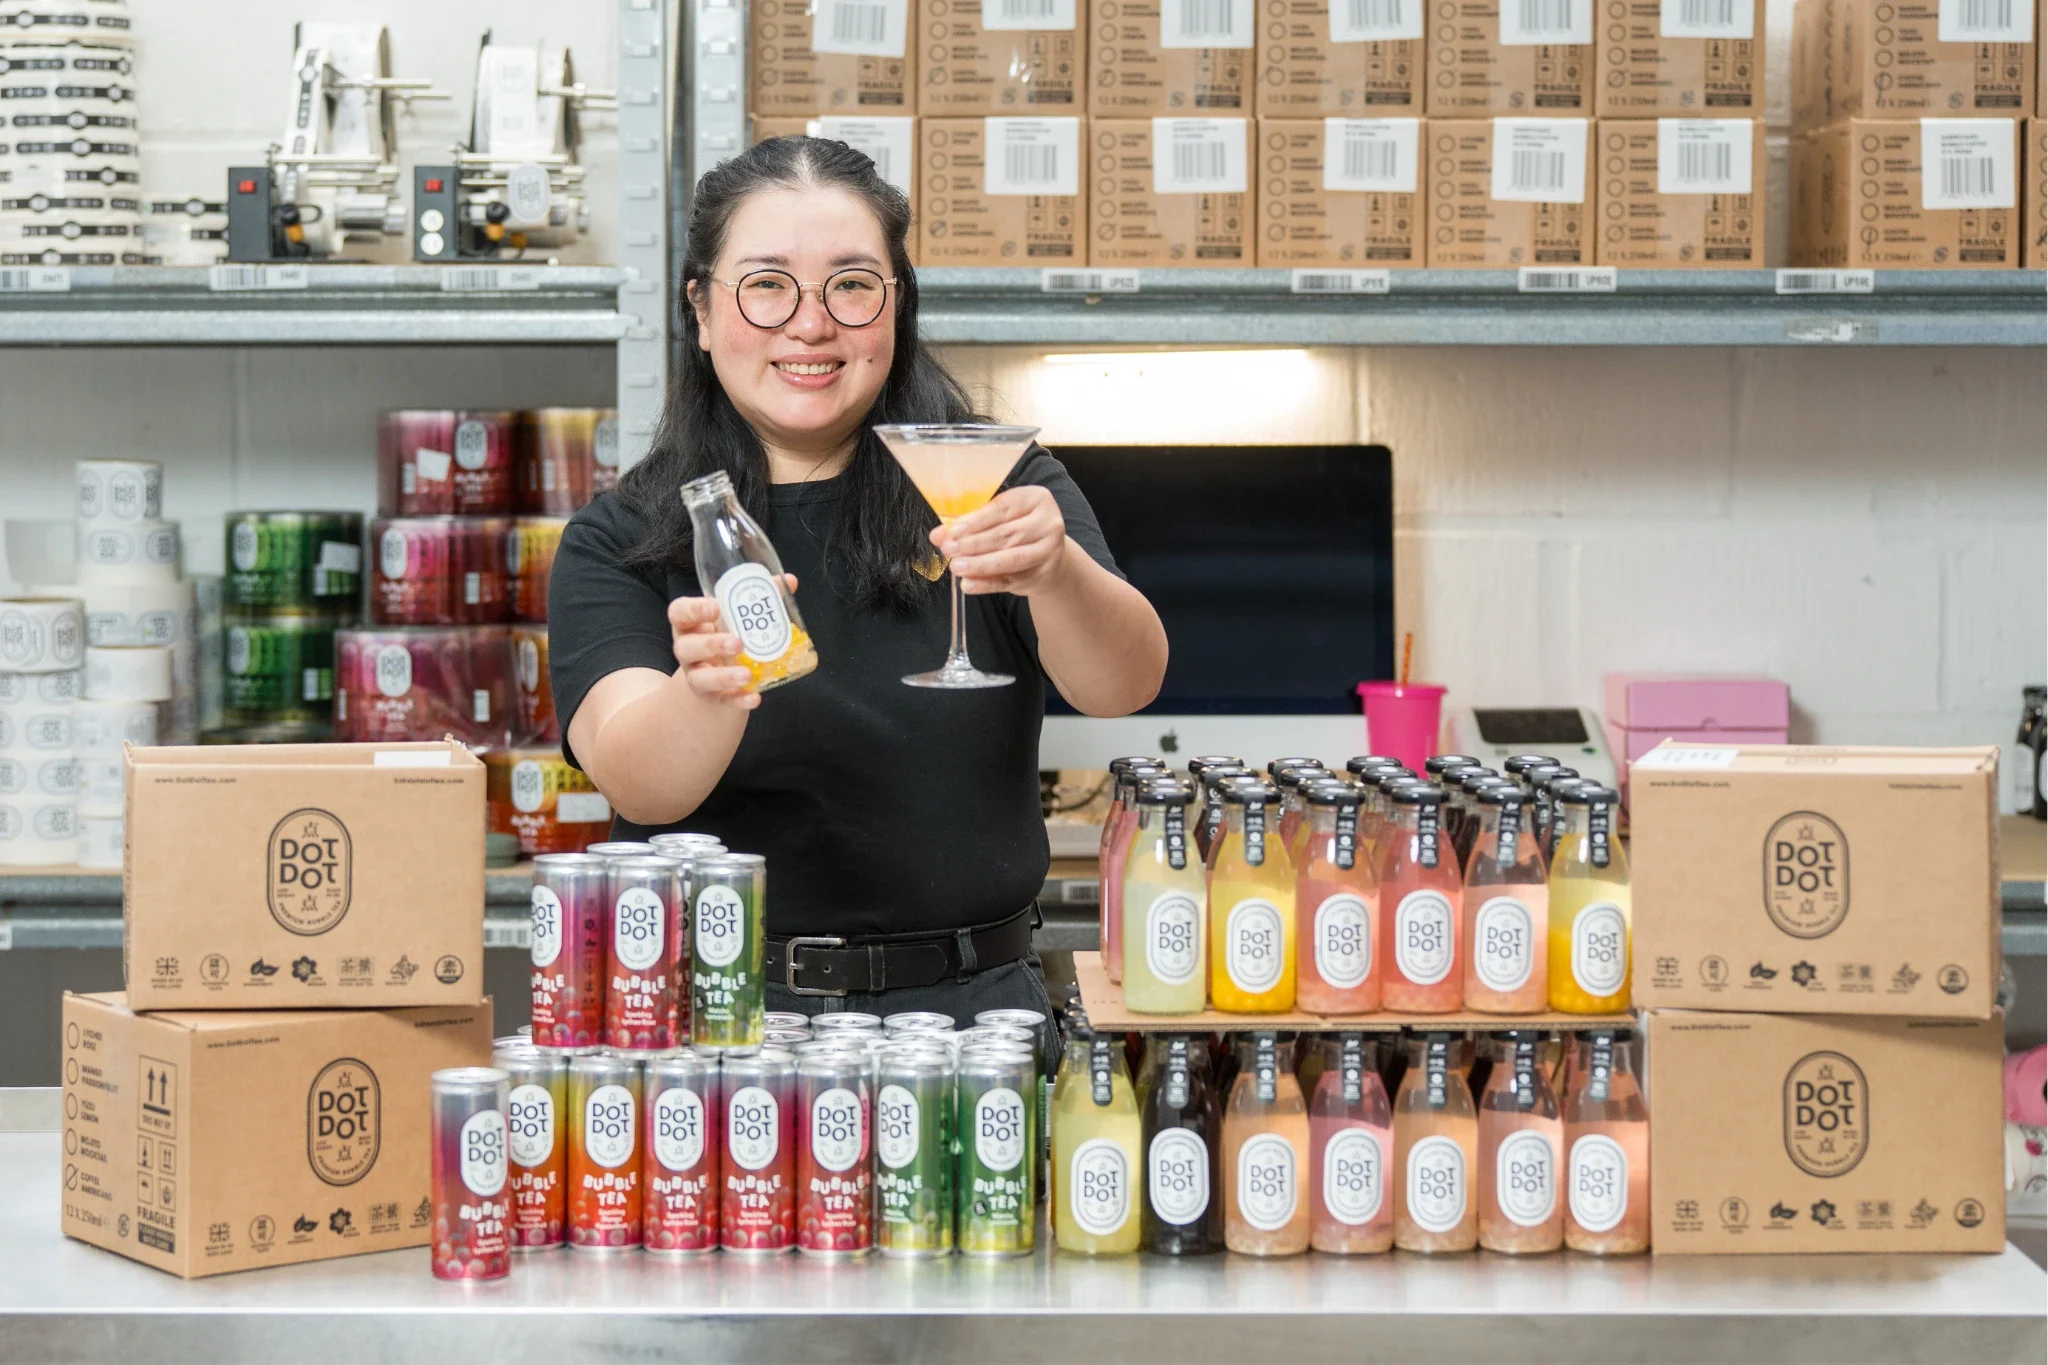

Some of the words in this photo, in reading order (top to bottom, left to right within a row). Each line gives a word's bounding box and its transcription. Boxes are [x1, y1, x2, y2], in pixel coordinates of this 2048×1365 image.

[1704, 83, 1752, 93] FRAGILE
[1974, 83, 2022, 92] FRAGILE
[1704, 237, 1752, 246] FRAGILE
[1959, 239, 2005, 247] FRAGILE
[738, 596, 772, 619] DOT
[742, 610, 776, 632] DOT
[281, 839, 339, 864] DOT
[1776, 841, 1835, 867] DOT
[281, 863, 339, 889] DOT
[1776, 865, 1835, 892] DOT
[621, 905, 658, 922] DOT
[701, 902, 738, 920] DOT
[621, 922, 658, 940] DOT
[701, 918, 738, 937] DOT
[1159, 920, 1192, 937] DOT
[1328, 924, 1362, 940] DOT
[1408, 920, 1444, 937] DOT
[1487, 926, 1522, 943] DOT
[1159, 936, 1192, 952] DOT
[1241, 929, 1271, 944] DOT
[1408, 936, 1444, 952] DOT
[1588, 932, 1618, 948] DOT
[1241, 944, 1271, 959] DOT
[1328, 939, 1362, 956] DOT
[1487, 941, 1522, 959] DOT
[1588, 947, 1618, 963] DOT
[612, 974, 666, 994] BUBBLE
[695, 971, 747, 991] BUBBLE
[624, 994, 654, 1009] TEA
[705, 990, 735, 1005] TEA
[83, 1027, 102, 1041] LYCHEE
[83, 1039, 96, 1051] ROSE
[82, 1064, 102, 1078] MANGO
[319, 1086, 369, 1114] DOT
[1796, 1081, 1855, 1106] DOT
[81, 1110, 99, 1124] LEMON
[510, 1102, 548, 1120] DOT
[592, 1103, 630, 1120] DOT
[660, 1105, 697, 1123] DOT
[734, 1104, 772, 1122] DOT
[819, 1106, 856, 1123] DOT
[982, 1105, 1020, 1124] DOT
[1796, 1104, 1855, 1131] DOT
[319, 1110, 369, 1139] DOT
[510, 1119, 548, 1137] DOT
[592, 1119, 630, 1138] DOT
[660, 1122, 697, 1141] DOT
[734, 1121, 772, 1140] DOT
[819, 1122, 856, 1142] DOT
[982, 1122, 1020, 1141] DOT
[468, 1128, 504, 1146] DOT
[468, 1144, 504, 1165] DOT
[1160, 1159, 1195, 1176] DOT
[1251, 1165, 1285, 1181] DOT
[1338, 1159, 1374, 1176] DOT
[1420, 1167, 1456, 1183] DOT
[1511, 1161, 1545, 1177] DOT
[1579, 1165, 1615, 1181] DOT
[80, 1172, 100, 1186] COFFEE
[511, 1171, 557, 1191] UBBLE
[583, 1171, 637, 1191] BUBBLE
[652, 1174, 707, 1195] BUBBLE
[727, 1173, 781, 1194] BUBBLE
[810, 1175, 865, 1196] BUBBLE
[974, 1175, 1027, 1196] BUBBLE
[1084, 1170, 1119, 1186] DOT
[1160, 1175, 1195, 1191] DOT
[1338, 1174, 1374, 1191] DOT
[1511, 1176, 1545, 1192] DOT
[1084, 1185, 1119, 1202] DOT
[1251, 1180, 1285, 1197] DOT
[1420, 1181, 1456, 1199] DOT
[1579, 1179, 1615, 1197] DOT
[516, 1191, 546, 1206] TEA
[597, 1192, 627, 1207] TEA
[665, 1195, 696, 1210] TEA
[739, 1194, 770, 1209] TEA
[824, 1196, 854, 1211] TEA
[883, 1192, 910, 1207] TEA
[988, 1195, 1019, 1211] TEA
[65, 1203, 75, 1218] 12
[74, 1206, 81, 1219] X
[137, 1206, 175, 1229] FRAGILE
[476, 1220, 504, 1237] TEA
